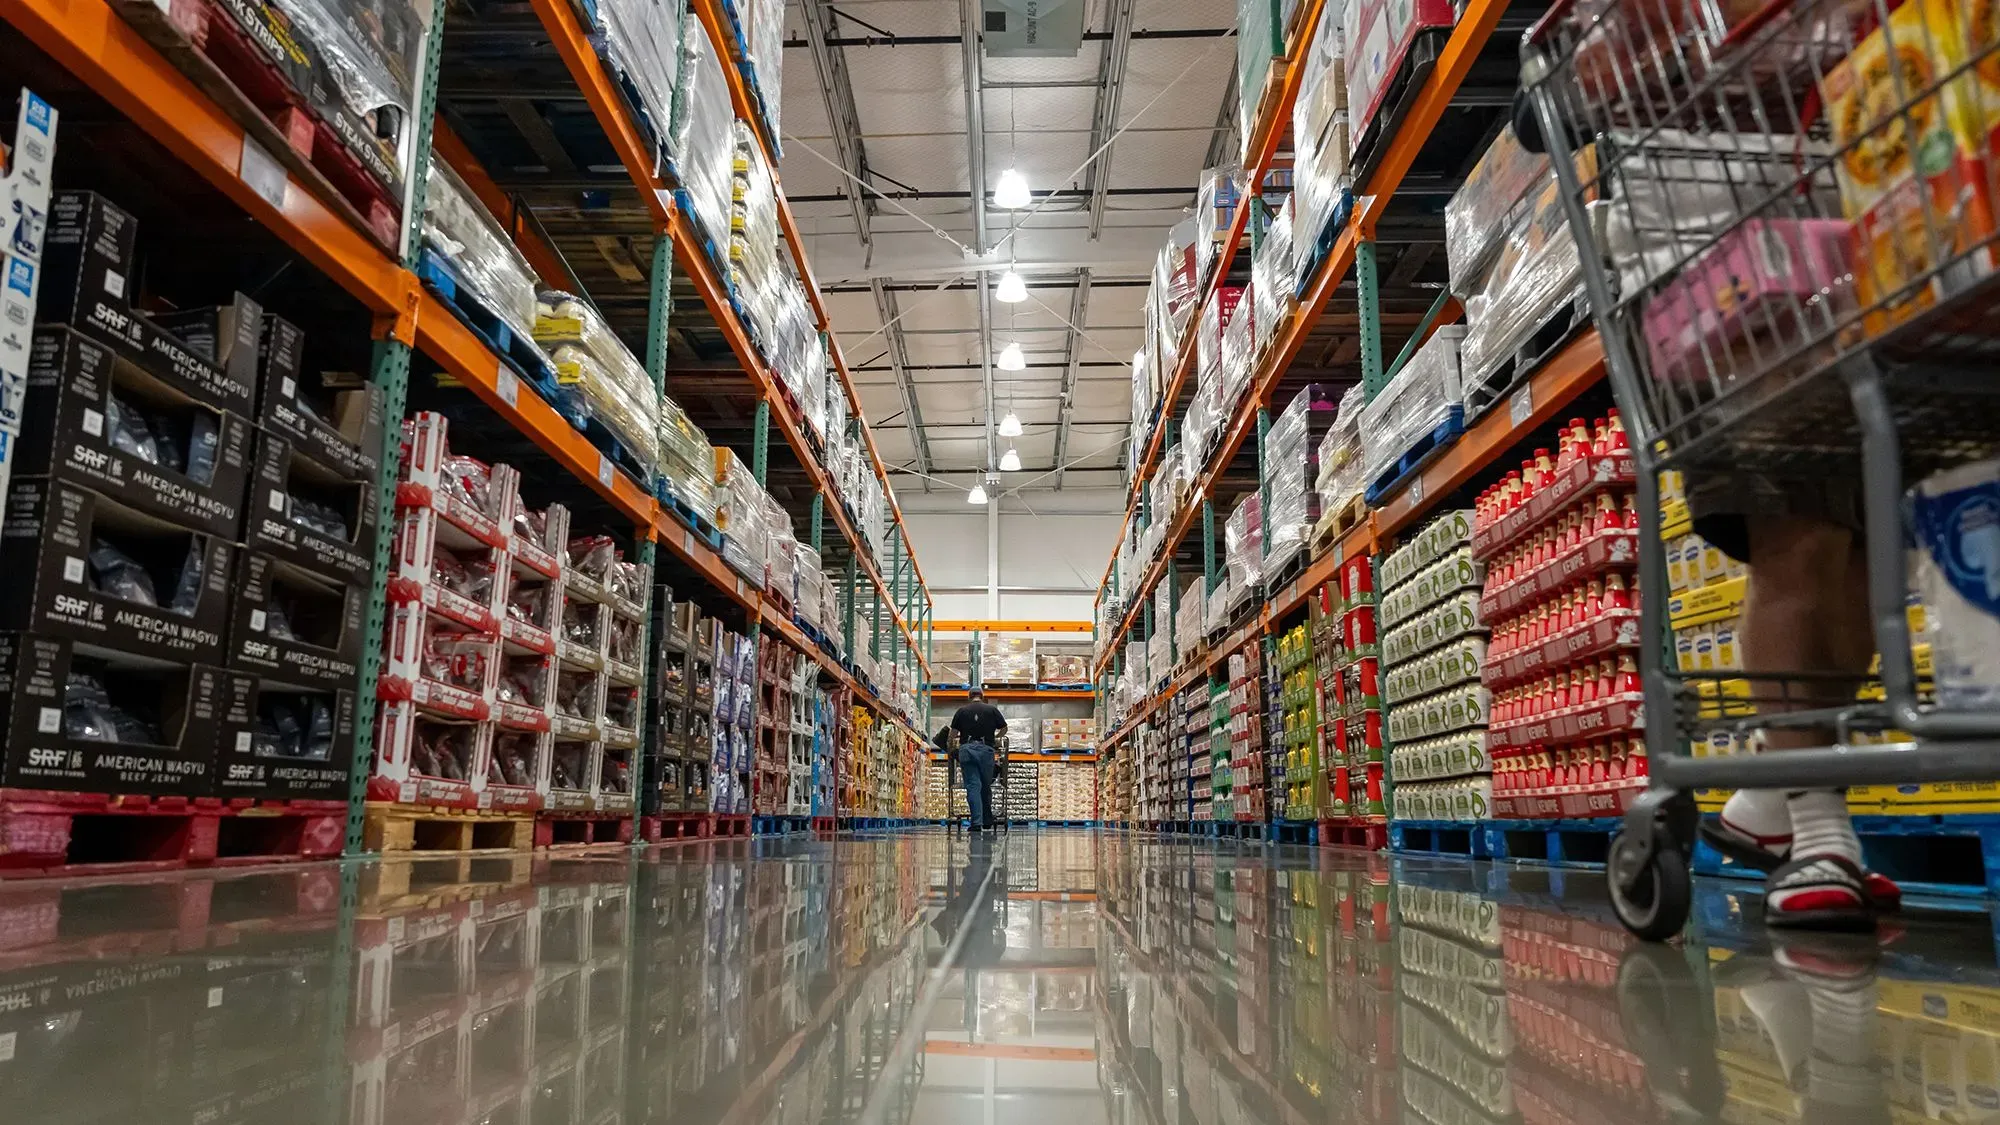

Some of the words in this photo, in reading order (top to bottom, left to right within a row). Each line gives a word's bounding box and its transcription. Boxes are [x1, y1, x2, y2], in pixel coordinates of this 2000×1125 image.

[245, 7, 285, 60] STRIPS
[335, 111, 366, 153] STEAK
[363, 143, 393, 183] STRIPS
[95, 302, 129, 329] SRF
[151, 336, 211, 380] AMERICAN
[212, 371, 248, 399] WAGYU
[174, 362, 198, 381] BEEF
[73, 444, 109, 468] SRF
[133, 470, 197, 504] AMERICAN
[198, 495, 234, 520] WAGYU
[1552, 475, 1573, 497] KEWPIE
[155, 491, 182, 509] BEEF
[1563, 552, 1585, 573] KEWPIE
[54, 594, 89, 616] SRF
[114, 610, 178, 637] AMERICAN
[180, 625, 218, 646] WAGYU
[138, 629, 164, 642] BEEF
[1568, 631, 1592, 652] KEWPIE
[1577, 712, 1604, 729] KEWPIE
[28, 748, 67, 767] SRF
[94, 754, 163, 772] AMERICAN
[165, 760, 206, 775] WAGYU
[120, 771, 147, 782] BEEF
[1588, 794, 1615, 810] KEWPIE
